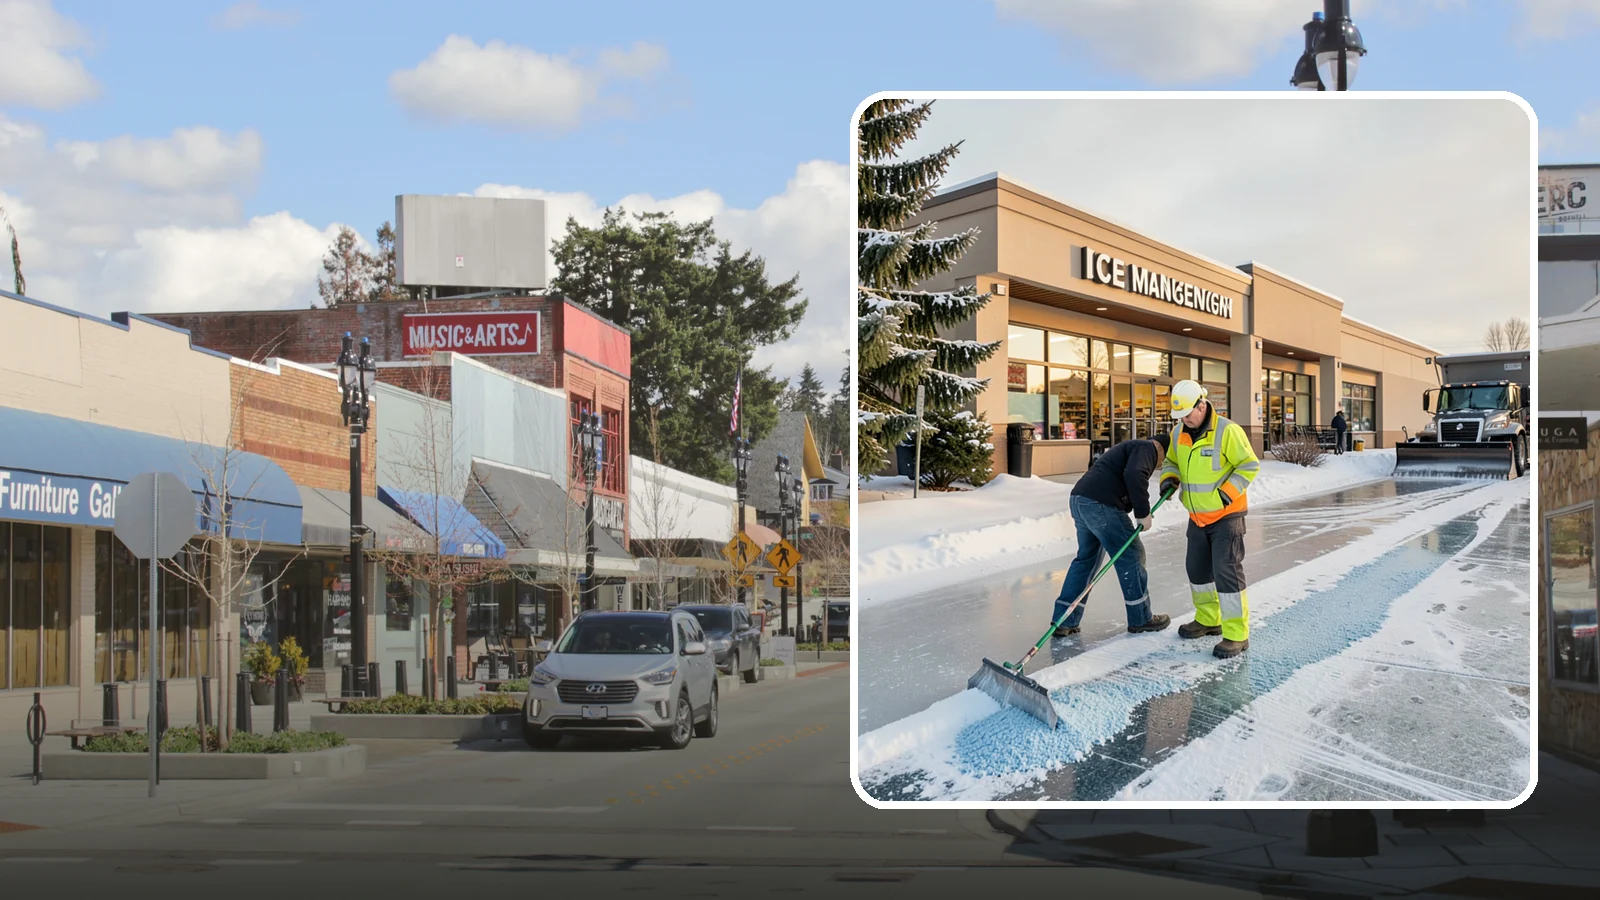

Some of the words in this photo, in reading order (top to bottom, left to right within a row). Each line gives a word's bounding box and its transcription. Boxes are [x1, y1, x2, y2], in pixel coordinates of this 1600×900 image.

[1082, 246, 1125, 288] ICE
[408, 322, 520, 349] MUSIC&ARTS
[1540, 427, 1577, 436] UGA
[0, 471, 79, 516] Furniture
[89, 482, 122, 519] Gal
